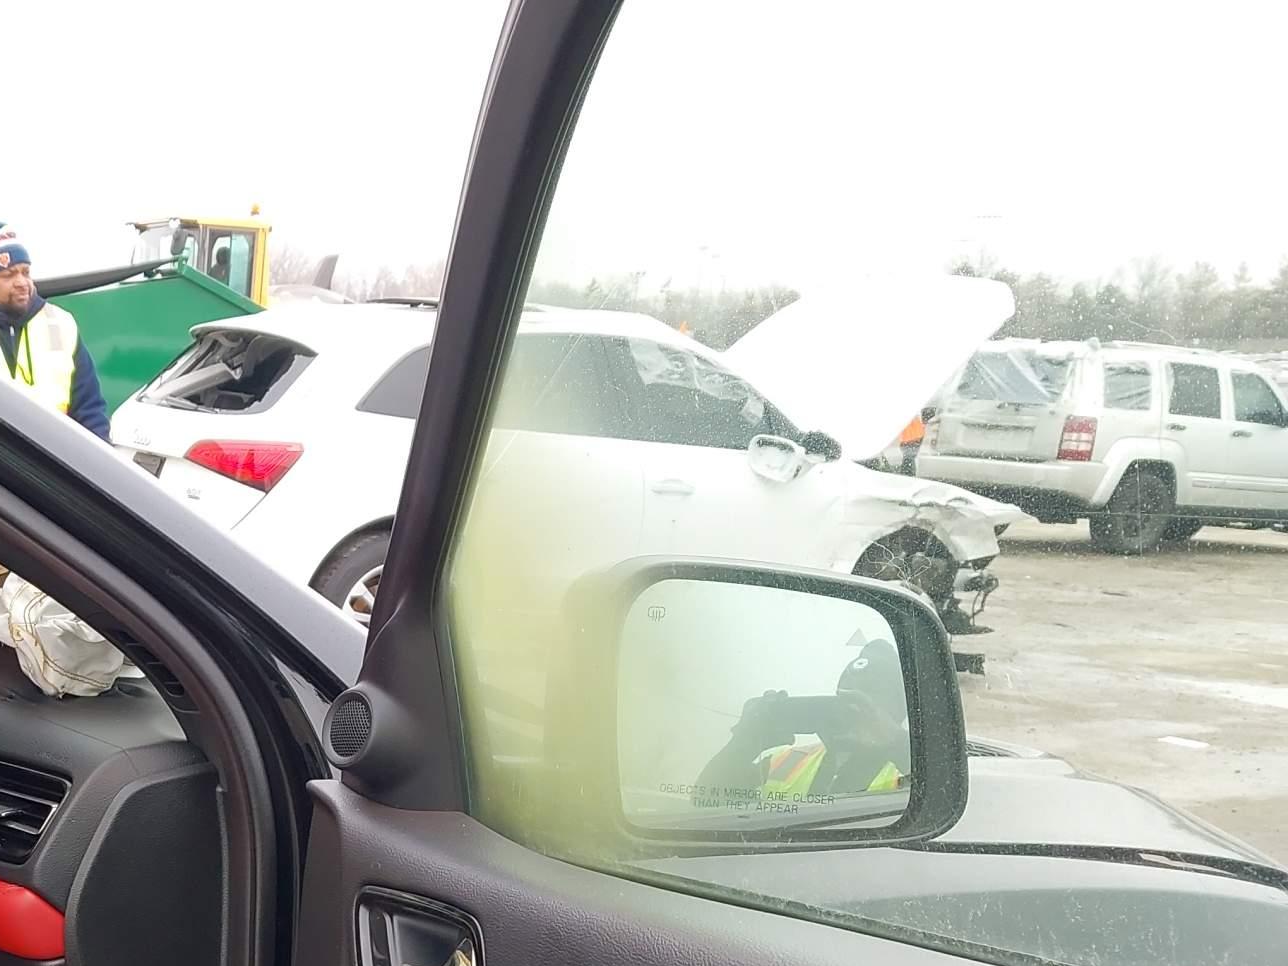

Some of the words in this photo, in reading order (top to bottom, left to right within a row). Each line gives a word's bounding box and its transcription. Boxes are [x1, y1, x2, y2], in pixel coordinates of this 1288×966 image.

[658, 783, 706, 796] OBJECTS
[710, 786, 721, 797] IN
[724, 786, 762, 800] MIRROR
[766, 789, 789, 802] ARE
[792, 792, 835, 805] CLOSER
[693, 796, 720, 809] THAN
[725, 799, 751, 811] THEY
[755, 802, 798, 814] APPEAR
